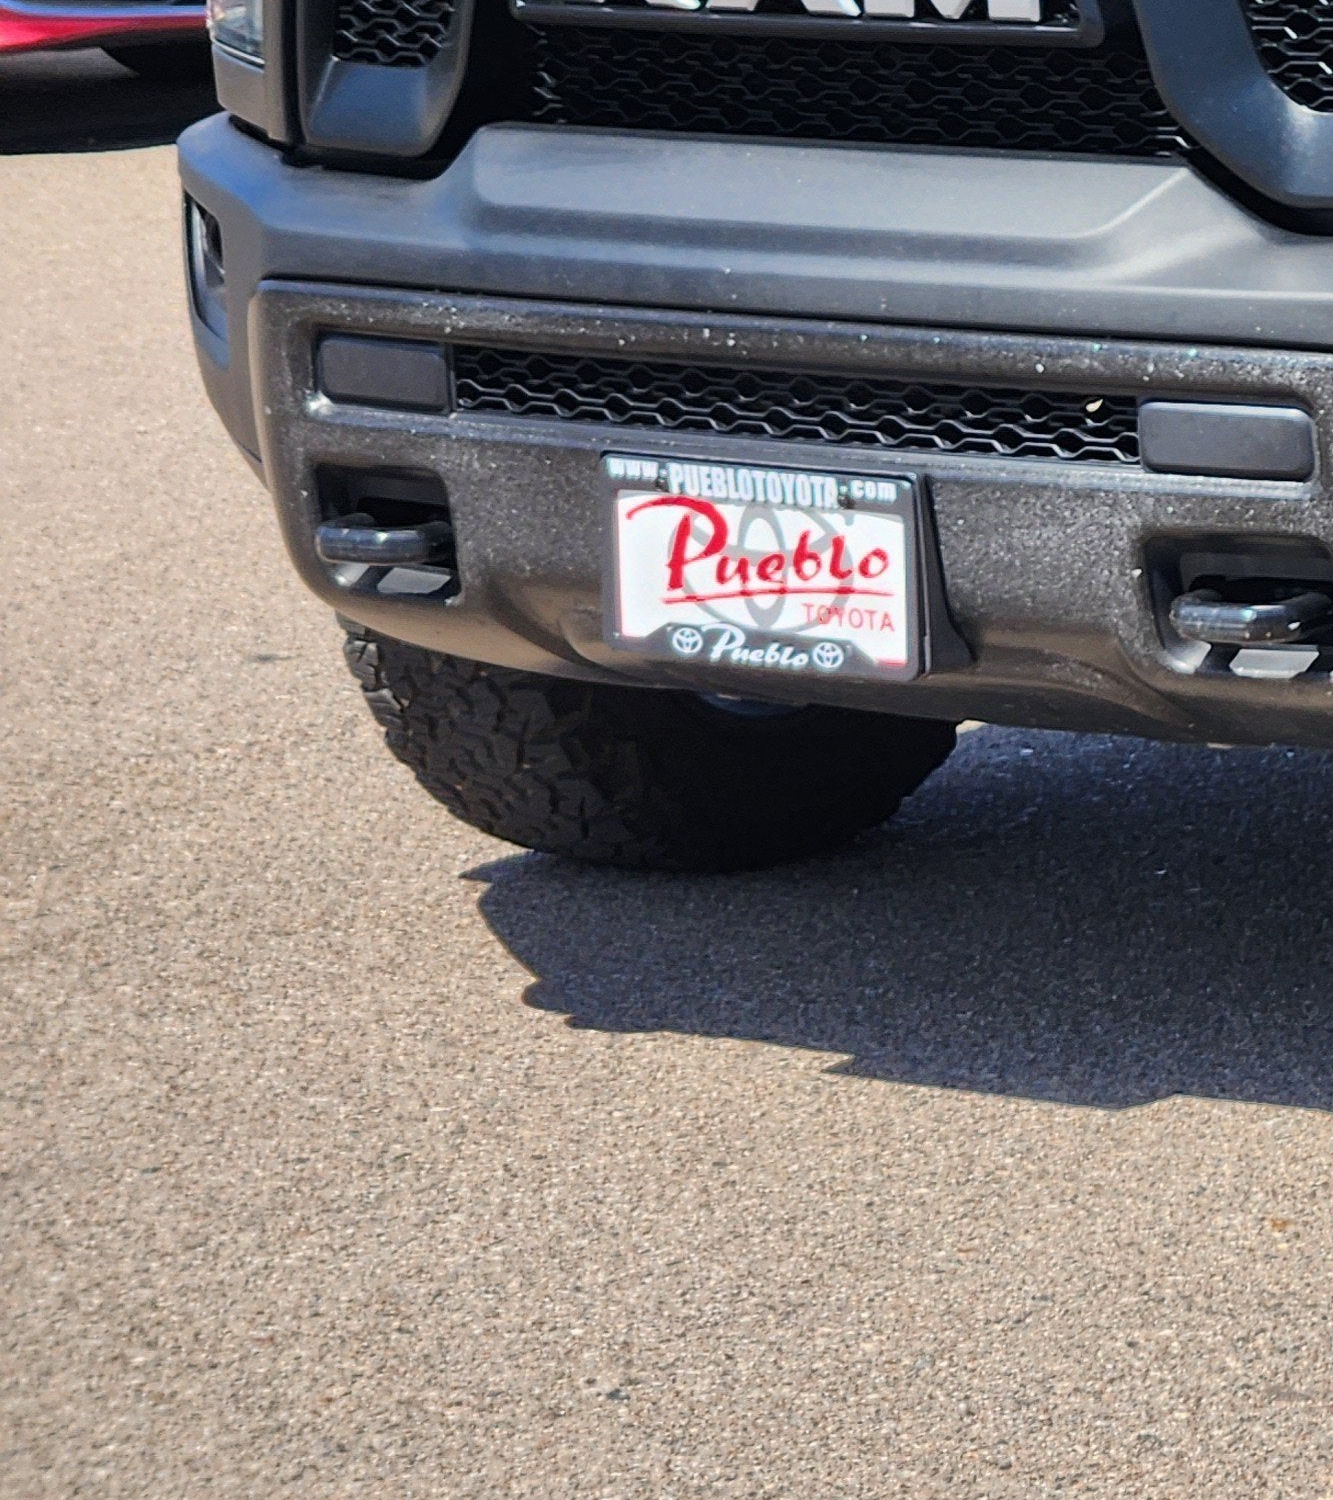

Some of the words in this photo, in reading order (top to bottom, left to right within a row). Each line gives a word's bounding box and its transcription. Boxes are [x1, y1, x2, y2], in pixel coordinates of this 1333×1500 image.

[626, 494, 891, 592] Pueblo
[802, 602, 896, 633] TOYOTA
[701, 621, 811, 669] Pueblo
